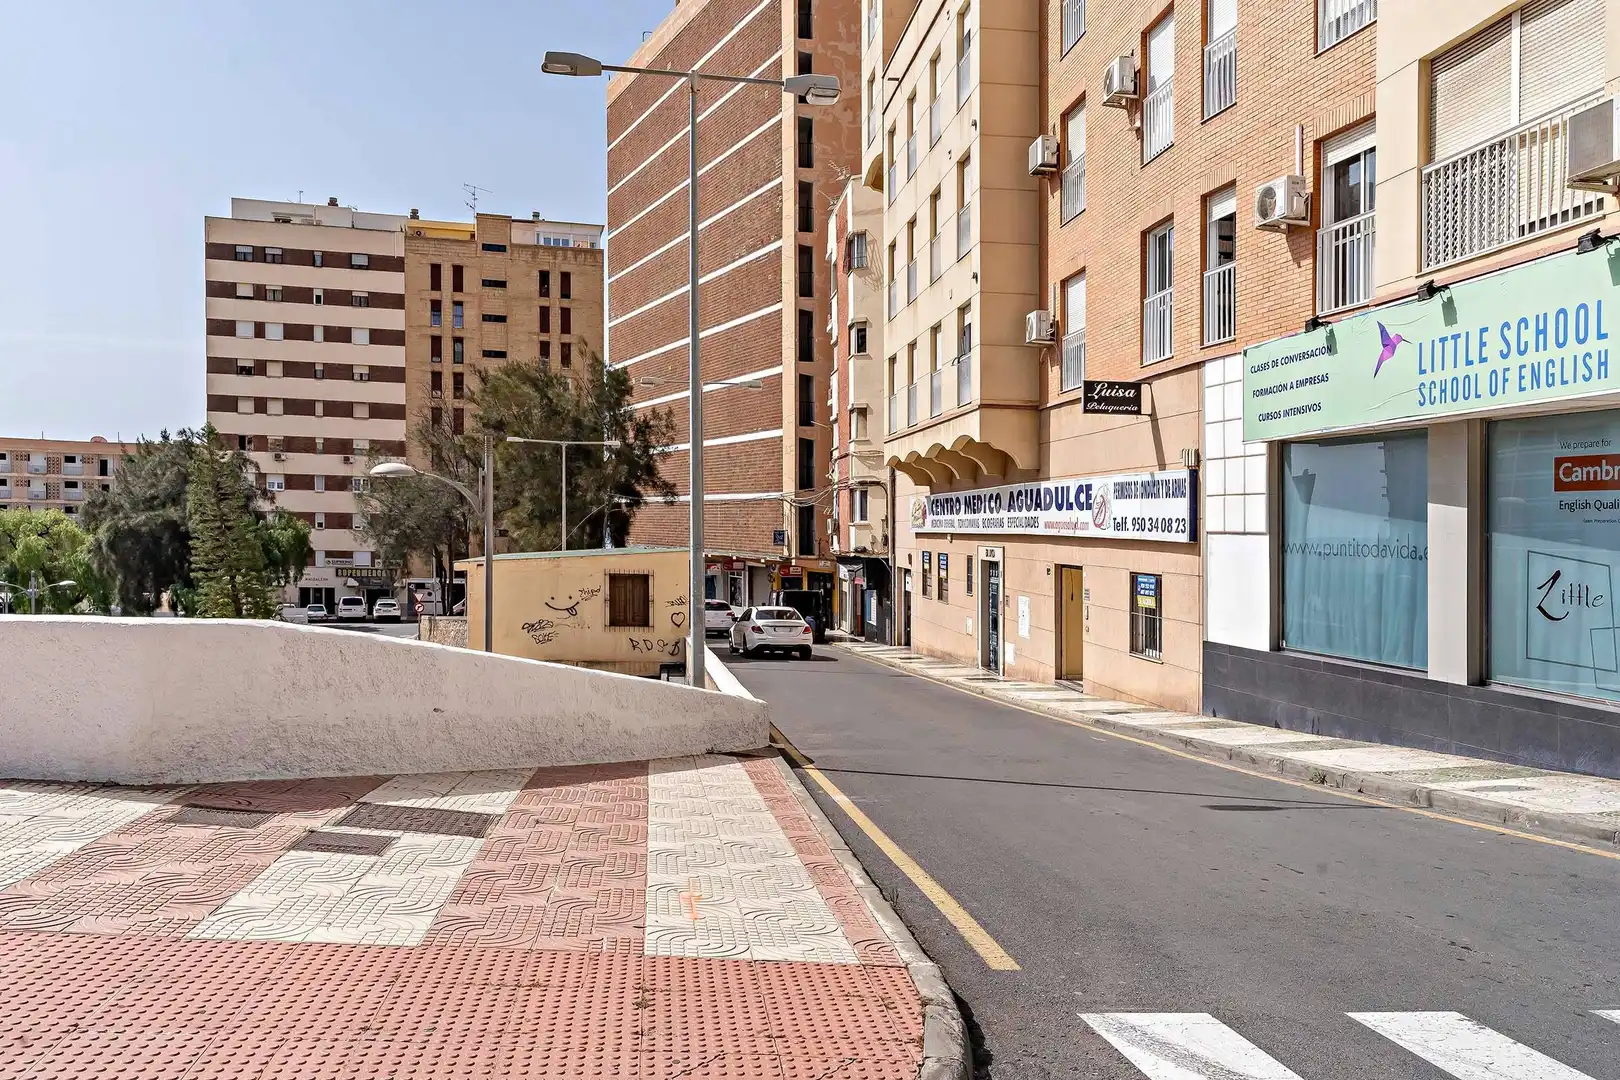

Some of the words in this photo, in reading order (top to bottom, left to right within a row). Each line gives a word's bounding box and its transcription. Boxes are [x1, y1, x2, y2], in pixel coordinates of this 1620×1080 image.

[1418, 327, 1489, 375] LITTLE
[1499, 300, 1609, 360] SCHOOL
[1250, 361, 1270, 374] CLASES
[1271, 358, 1279, 369] DE
[1280, 343, 1332, 366] CONVERSACIÓN
[1252, 382, 1288, 398] FORMACIÓN
[1289, 381, 1295, 390] A
[1295, 373, 1329, 389] EMPRESAS
[1418, 373, 1481, 407] SCHOOL
[1489, 367, 1511, 397] OF
[1518, 348, 1609, 393] ENGLISH
[1088, 382, 1137, 399] Luisa
[1258, 410, 1281, 422] CURSOS
[1283, 402, 1322, 417] INTENSIVOS
[1560, 441, 1571, 450] We
[1573, 441, 1600, 451] prepare
[1602, 438, 1612, 447] for
[931, 497, 962, 516] CENTRO
[964, 492, 1002, 515] MEDICO
[1007, 484, 1093, 512] AGUADULCE
[1559, 499, 1591, 513] English
[1113, 516, 1129, 532] Telf.
[1131, 516, 1146, 532] 950
[1147, 517, 1160, 533] 34
[1160, 517, 1173, 533] 08
[1174, 517, 1187, 534] 23
